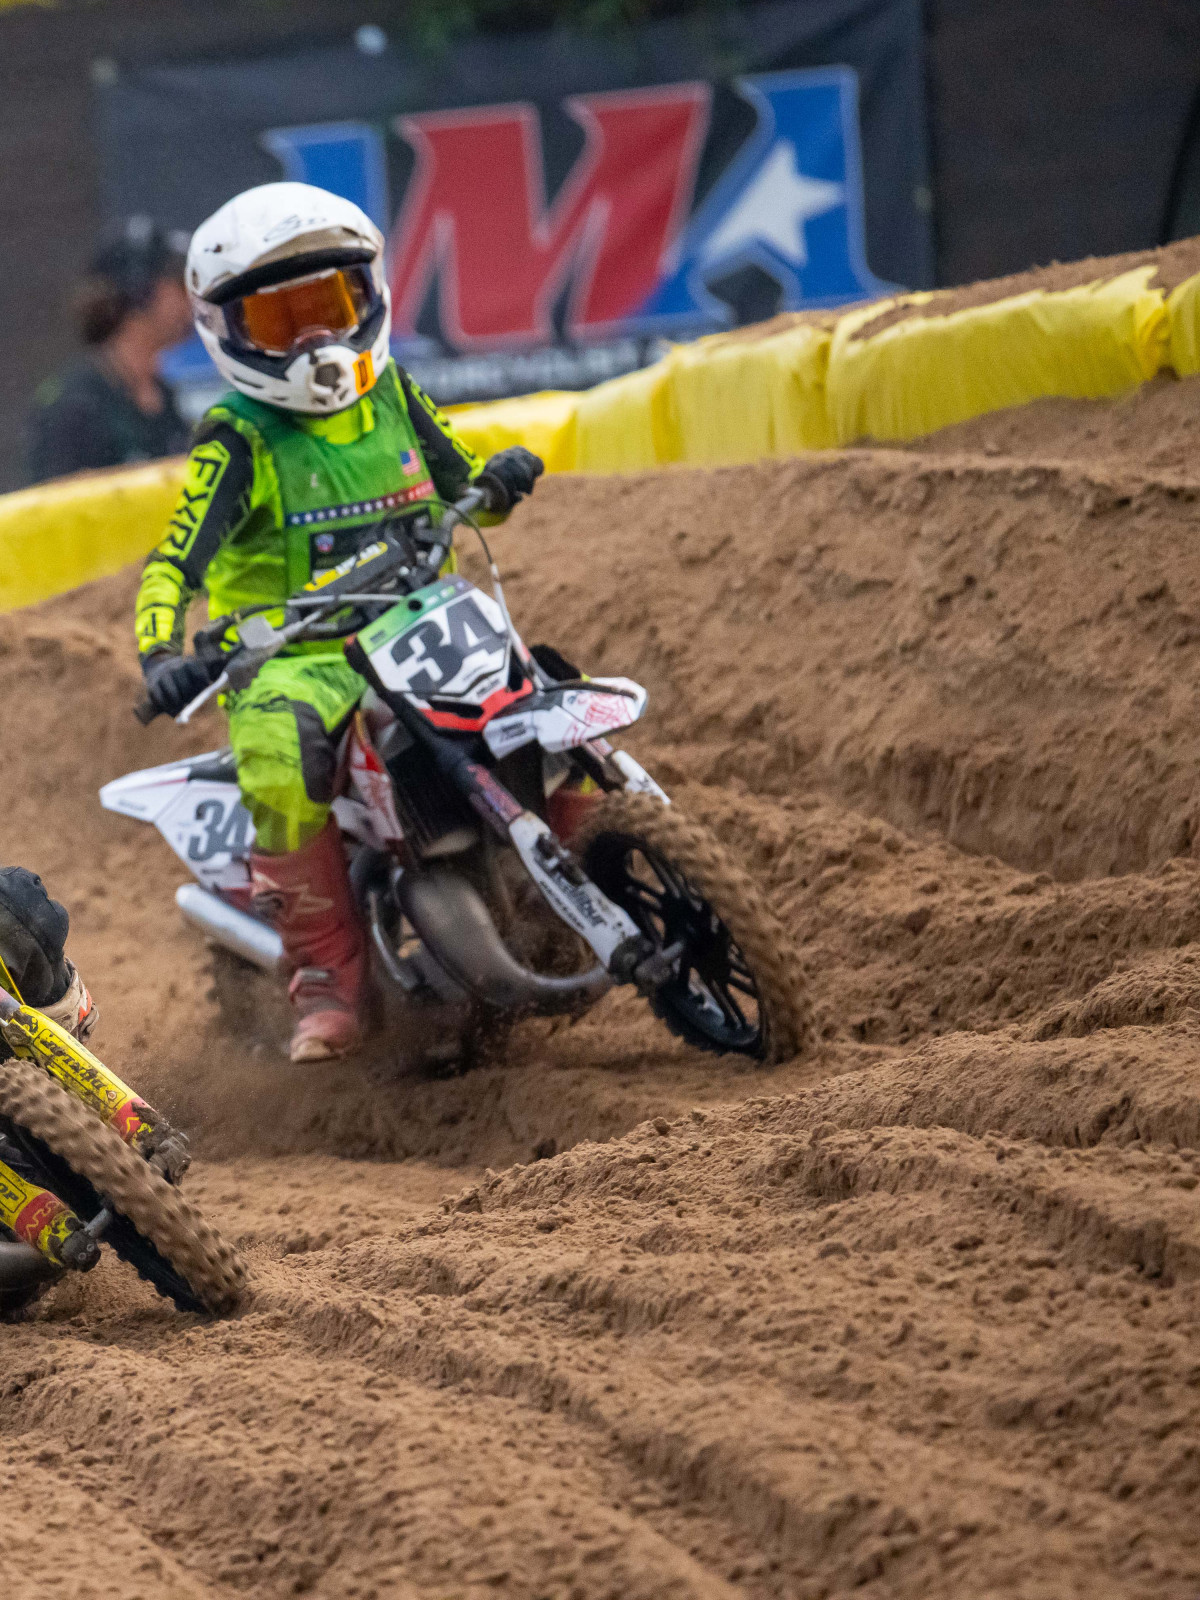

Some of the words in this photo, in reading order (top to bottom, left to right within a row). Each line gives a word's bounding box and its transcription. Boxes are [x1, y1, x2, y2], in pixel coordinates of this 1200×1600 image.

[169, 455, 223, 551] FXR
[390, 596, 514, 698] 34
[187, 799, 252, 862] 34
